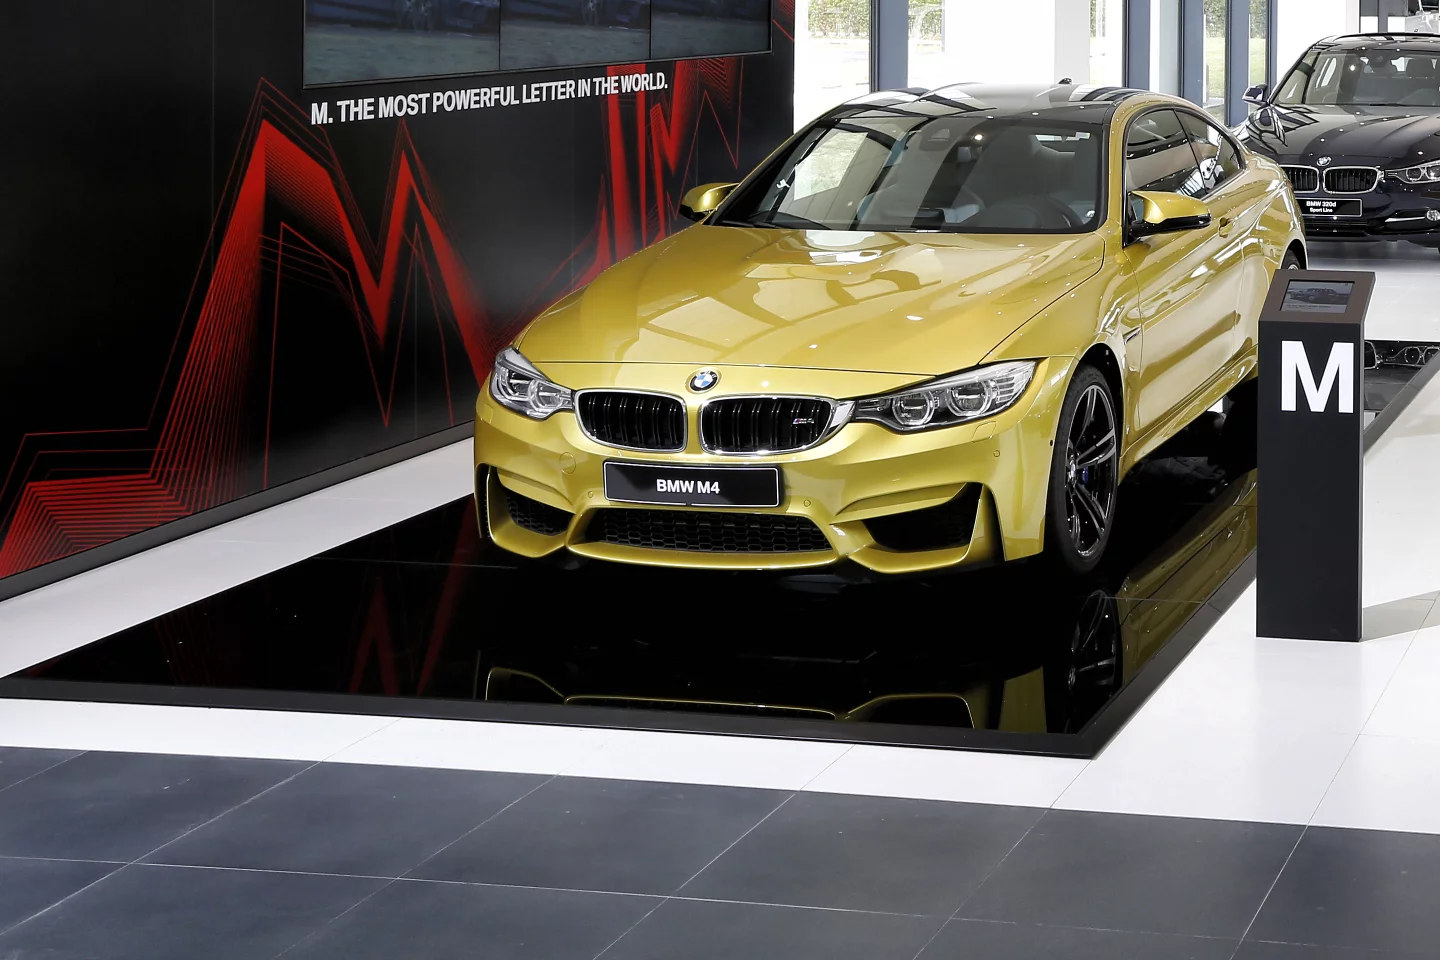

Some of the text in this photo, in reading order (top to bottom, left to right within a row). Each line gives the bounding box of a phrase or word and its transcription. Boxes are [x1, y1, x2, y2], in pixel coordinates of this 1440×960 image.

[311, 72, 668, 125] M. THE MOST POWERFUL LETTER IN THE WORLD.
[1281, 340, 1354, 413] M
[656, 478, 720, 494] BMW M4
